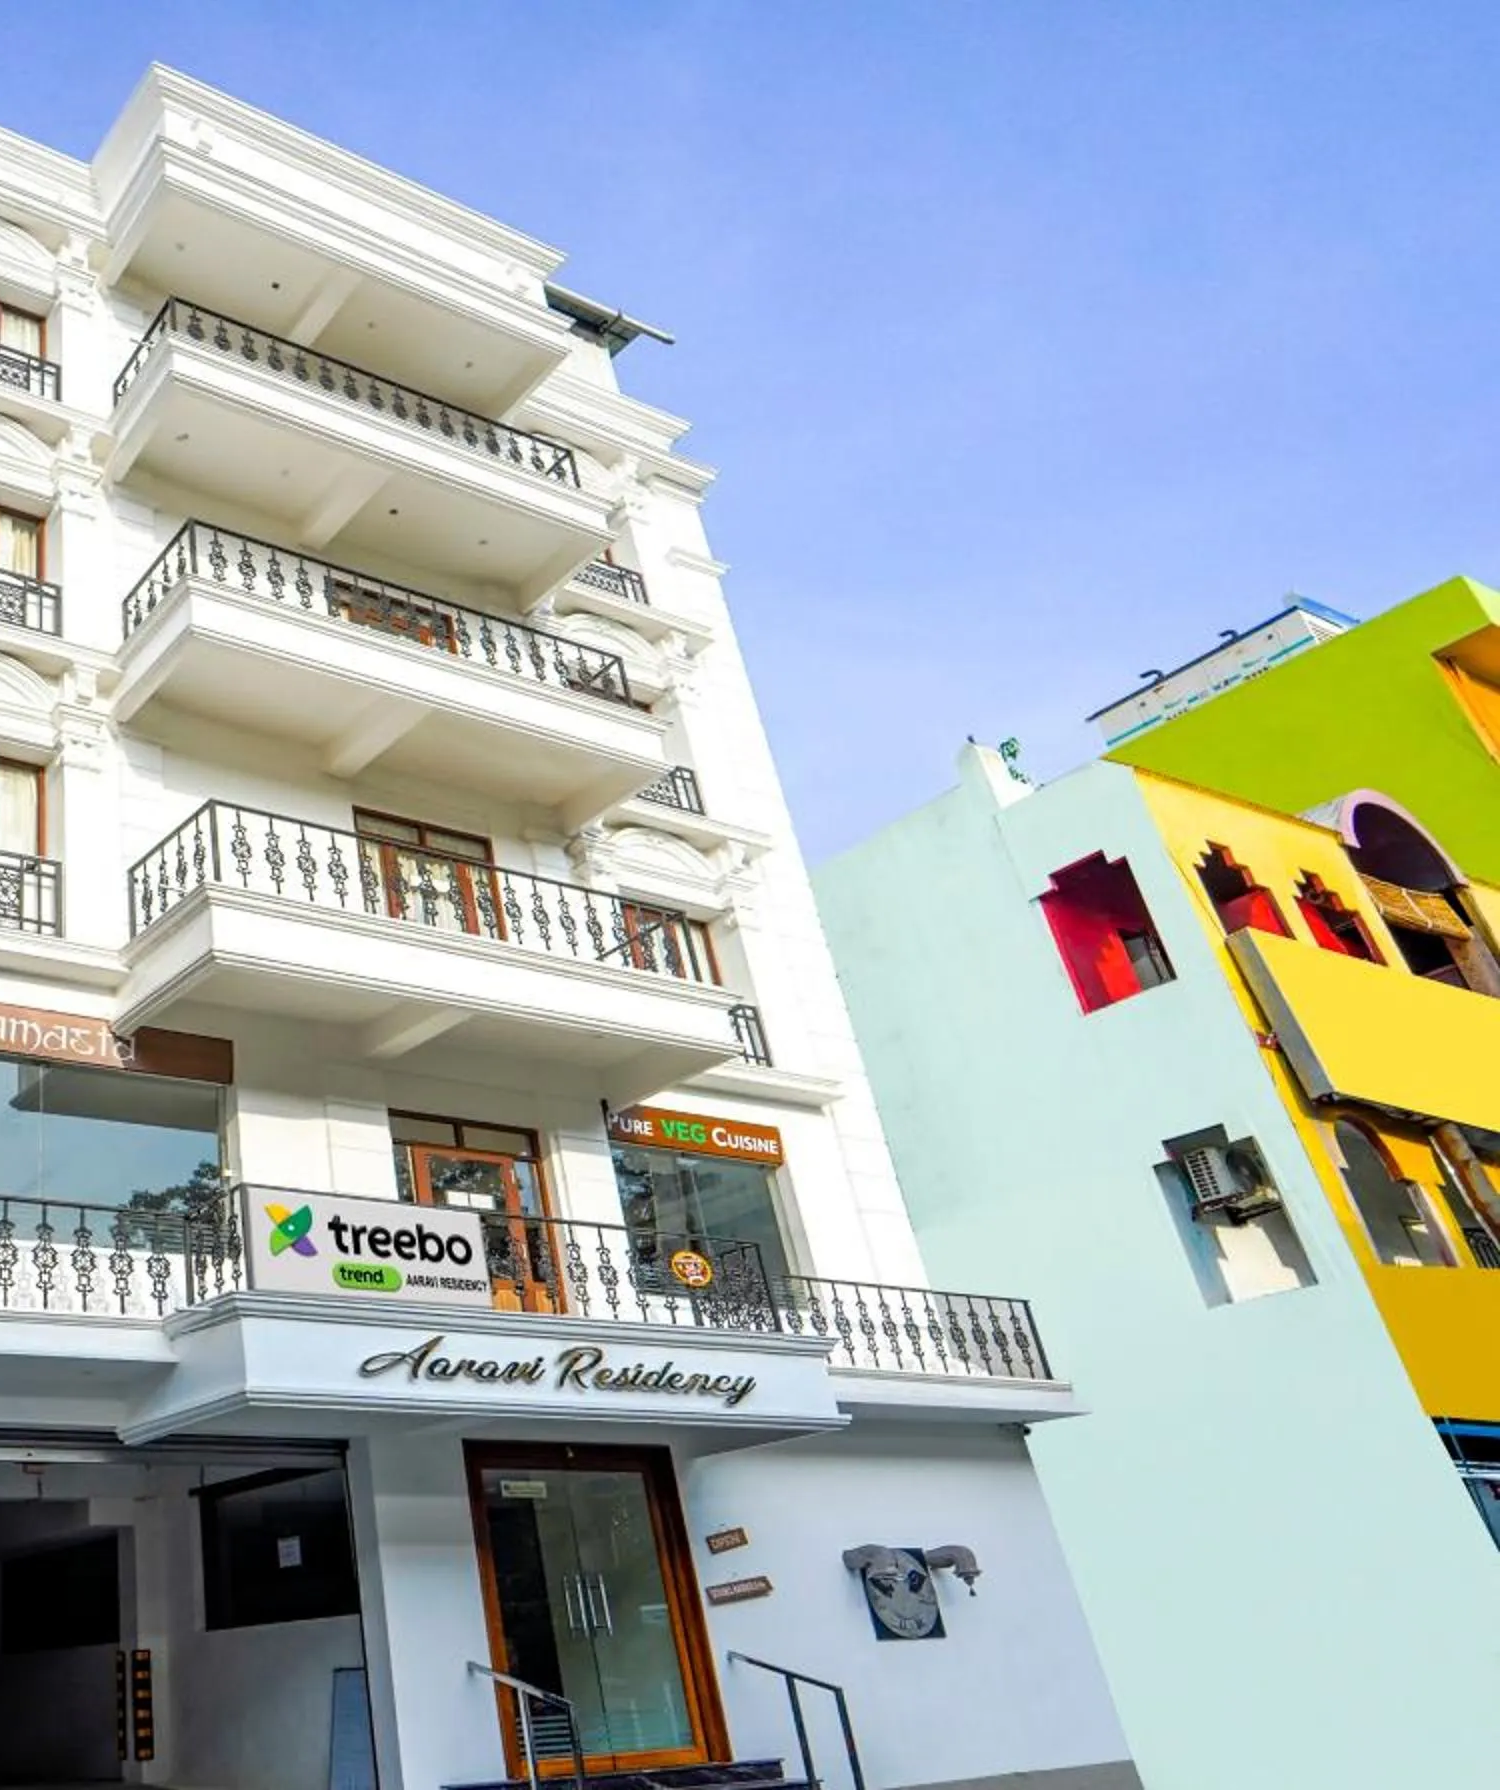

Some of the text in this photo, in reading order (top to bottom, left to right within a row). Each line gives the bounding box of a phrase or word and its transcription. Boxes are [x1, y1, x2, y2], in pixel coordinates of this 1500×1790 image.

[660, 1118, 707, 1145] VEG
[327, 1214, 473, 1266] treebo
[339, 1266, 384, 1284] trend
[359, 1335, 757, 1407] Aaravi Residency
